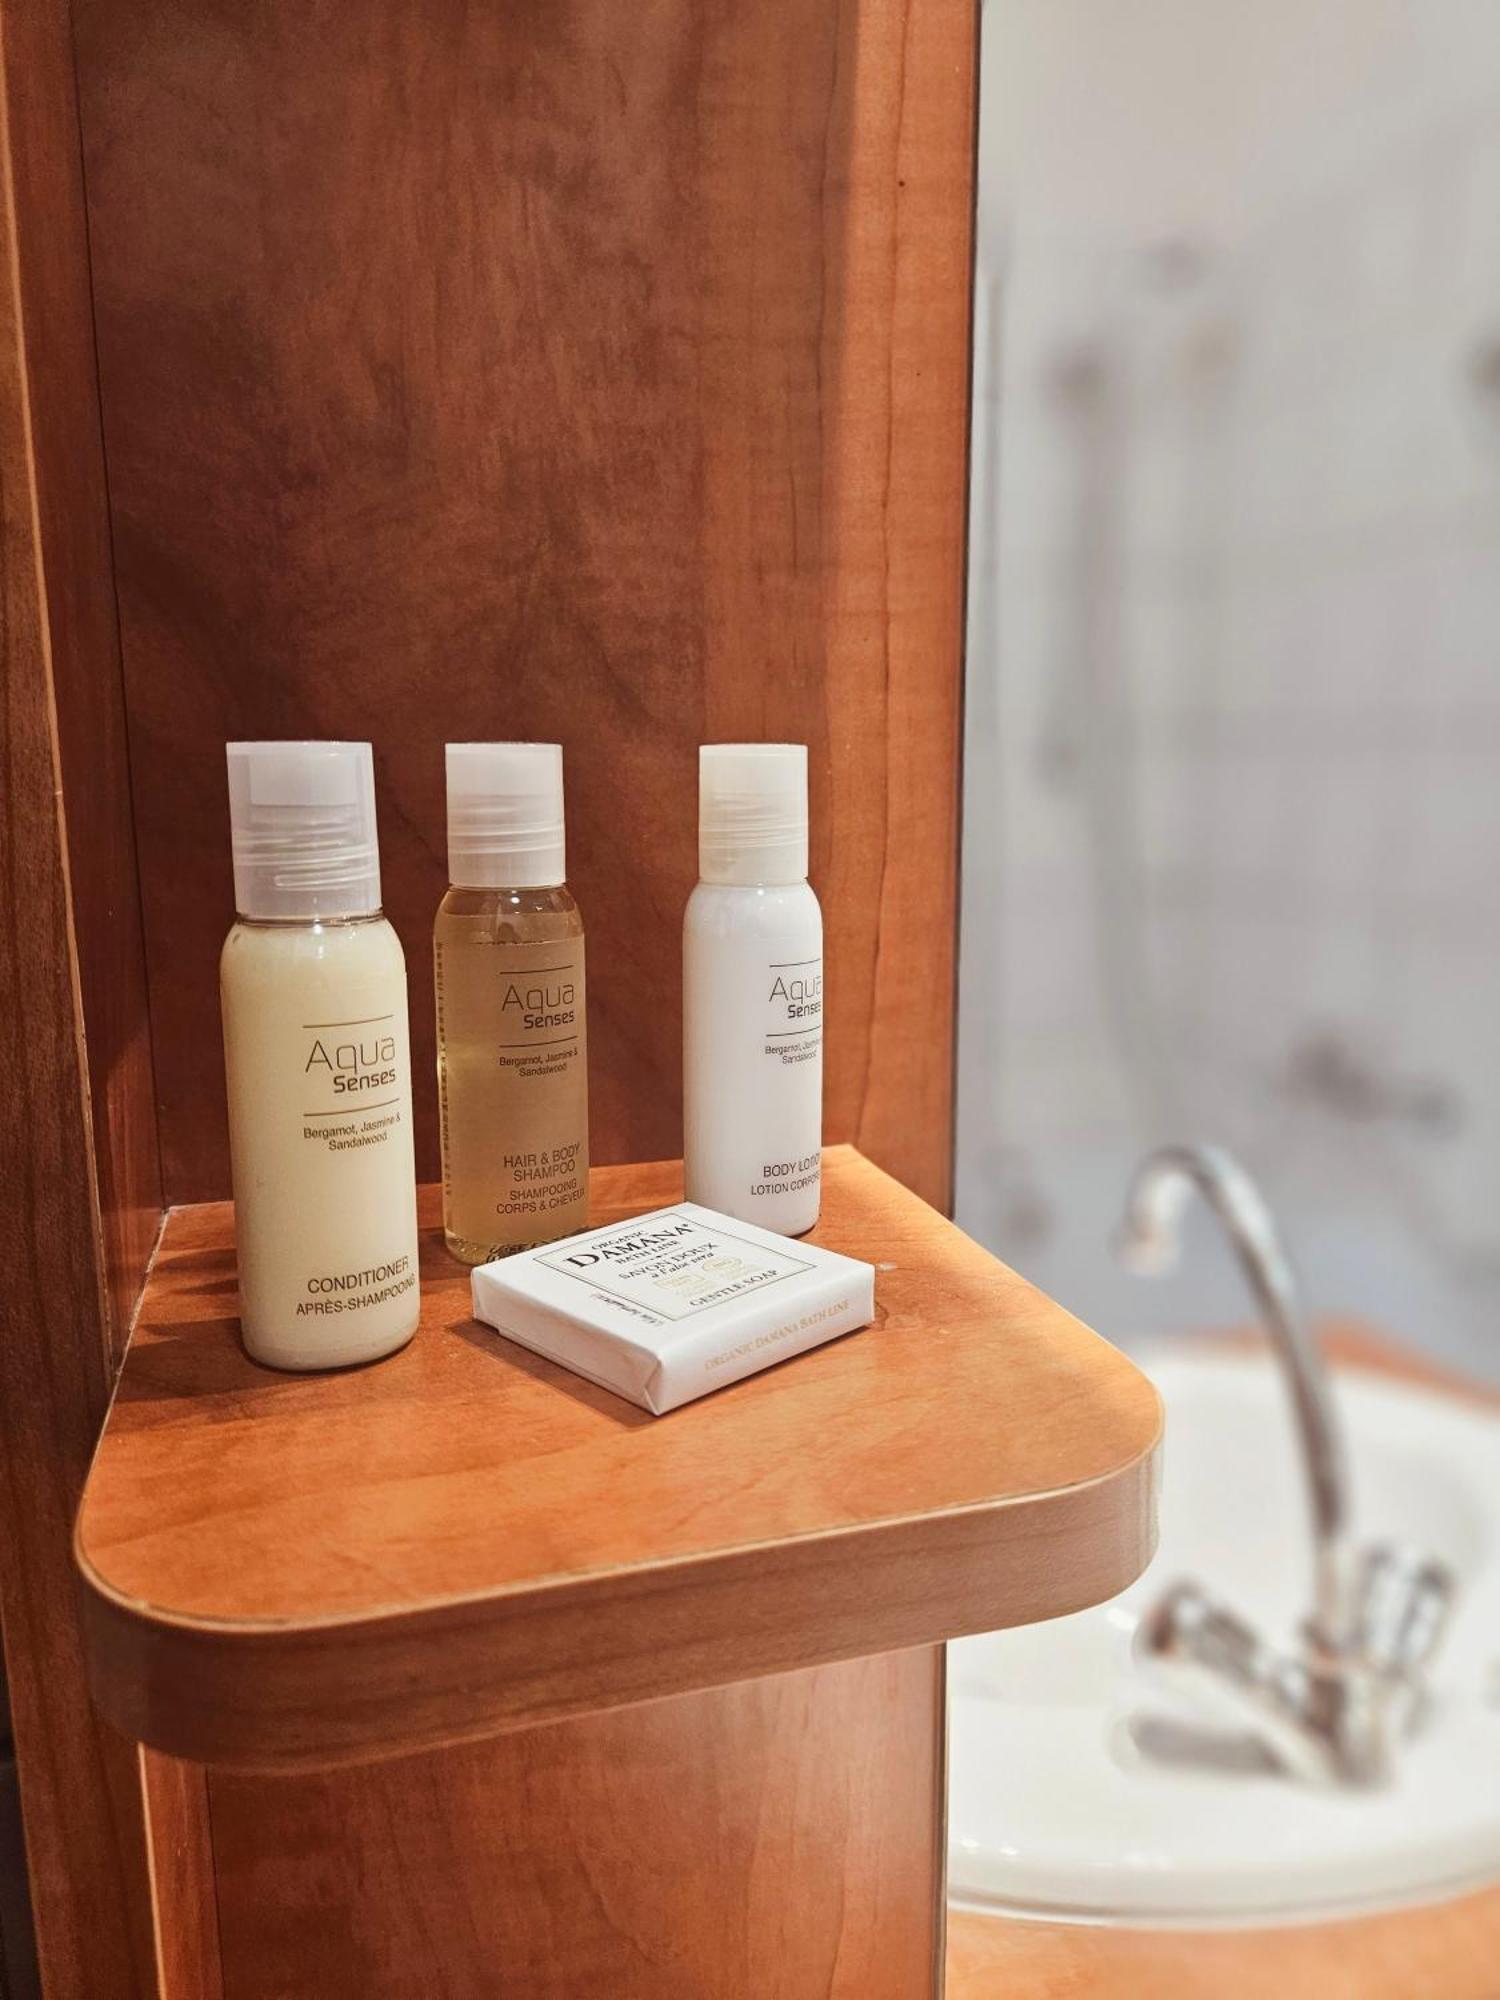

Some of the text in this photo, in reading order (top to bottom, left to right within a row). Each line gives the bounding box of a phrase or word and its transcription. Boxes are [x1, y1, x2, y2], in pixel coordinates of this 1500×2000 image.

[502, 984, 575, 1014] Aqua
[524, 1010, 575, 1030] Senses
[305, 1037, 395, 1074] Aqua
[499, 1055, 543, 1070] Bergamot,
[333, 1068, 396, 1094] Senses
[519, 1063, 567, 1077] Sandalwood
[304, 1125, 358, 1140] Bergamot,
[361, 1117, 394, 1132] Jasmine
[328, 1132, 387, 1150] Sandalwood
[503, 1143, 579, 1169] HAIR & BODY
[513, 1158, 575, 1183] SHAMPOO
[763, 1161, 797, 1178] BODY
[510, 1178, 577, 1202] SHAMPOOING
[751, 1183, 789, 1196] LOTION
[496, 1201, 537, 1215] CORPS
[539, 1199, 547, 1212] &
[564, 1227, 694, 1267] DAMANA
[619, 1260, 671, 1279] SAVON
[670, 1242, 719, 1263] DOUX
[307, 1255, 409, 1295] CONDITIONER
[689, 1282, 746, 1306] GENTLE
